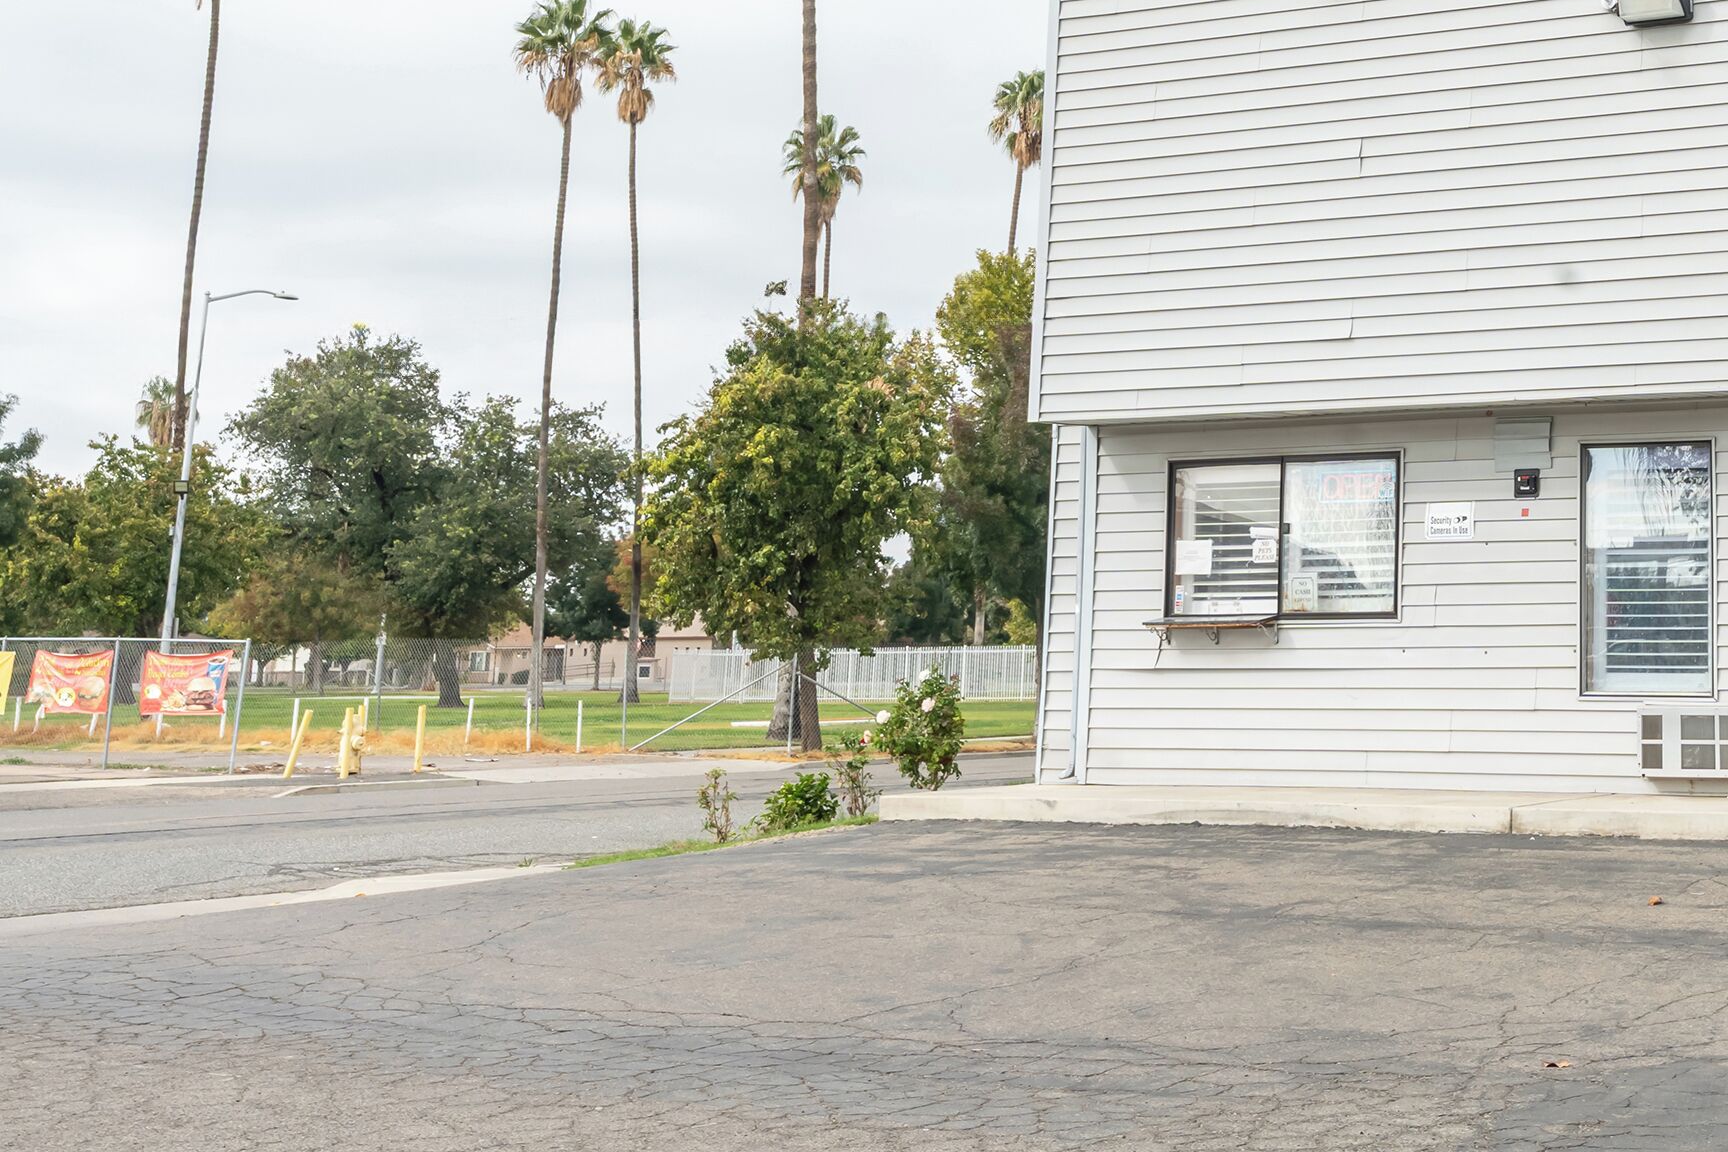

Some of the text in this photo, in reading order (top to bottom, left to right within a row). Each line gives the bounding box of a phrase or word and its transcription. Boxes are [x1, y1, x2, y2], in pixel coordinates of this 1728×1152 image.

[1430, 516, 1452, 526] Security
[1430, 526, 1452, 535] Cameras
[1459, 526, 1468, 535] Use
